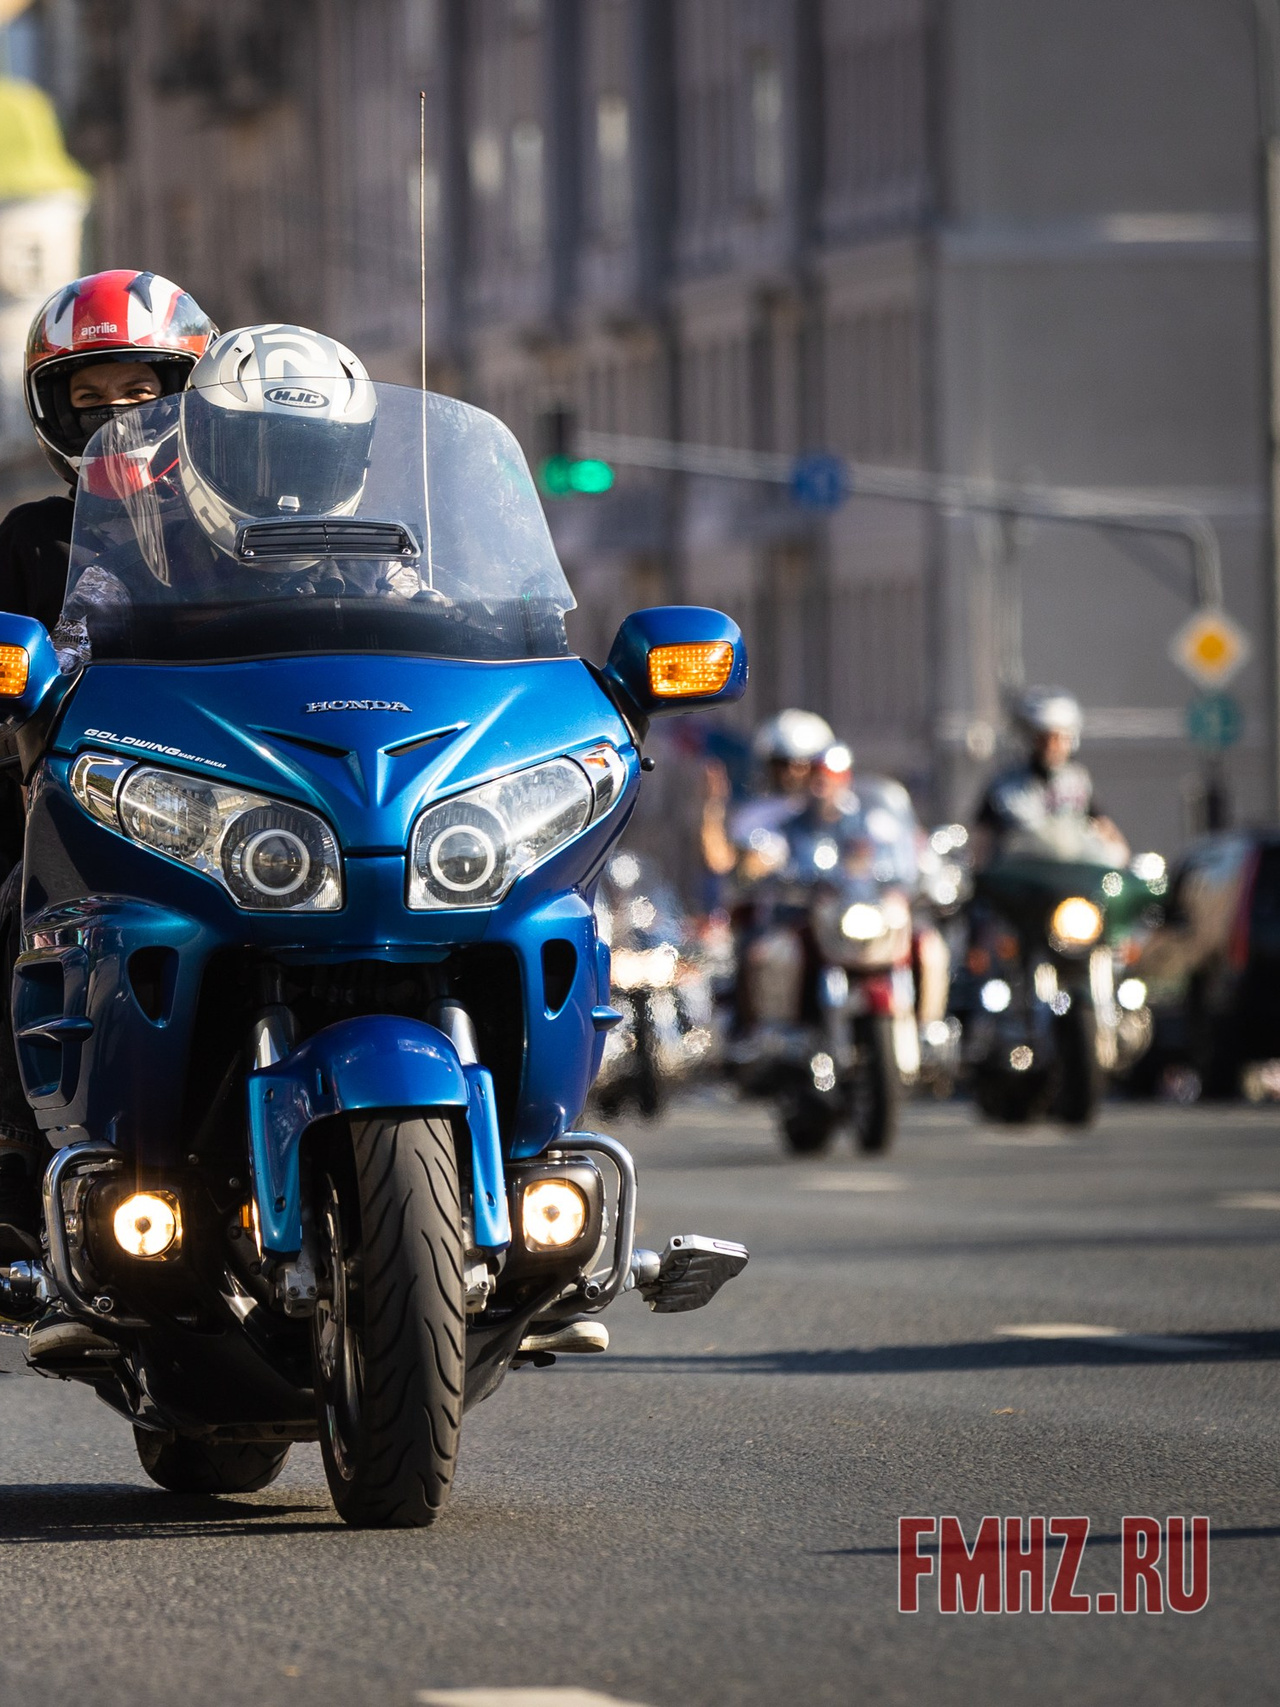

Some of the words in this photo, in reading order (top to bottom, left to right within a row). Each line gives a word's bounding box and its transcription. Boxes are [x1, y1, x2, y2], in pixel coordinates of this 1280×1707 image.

[81, 322, 117, 336] aprilia
[274, 391, 320, 404] HJC
[306, 700, 413, 713] HONDA
[84, 728, 181, 756] GOLDWING
[177, 752, 196, 761] MADE
